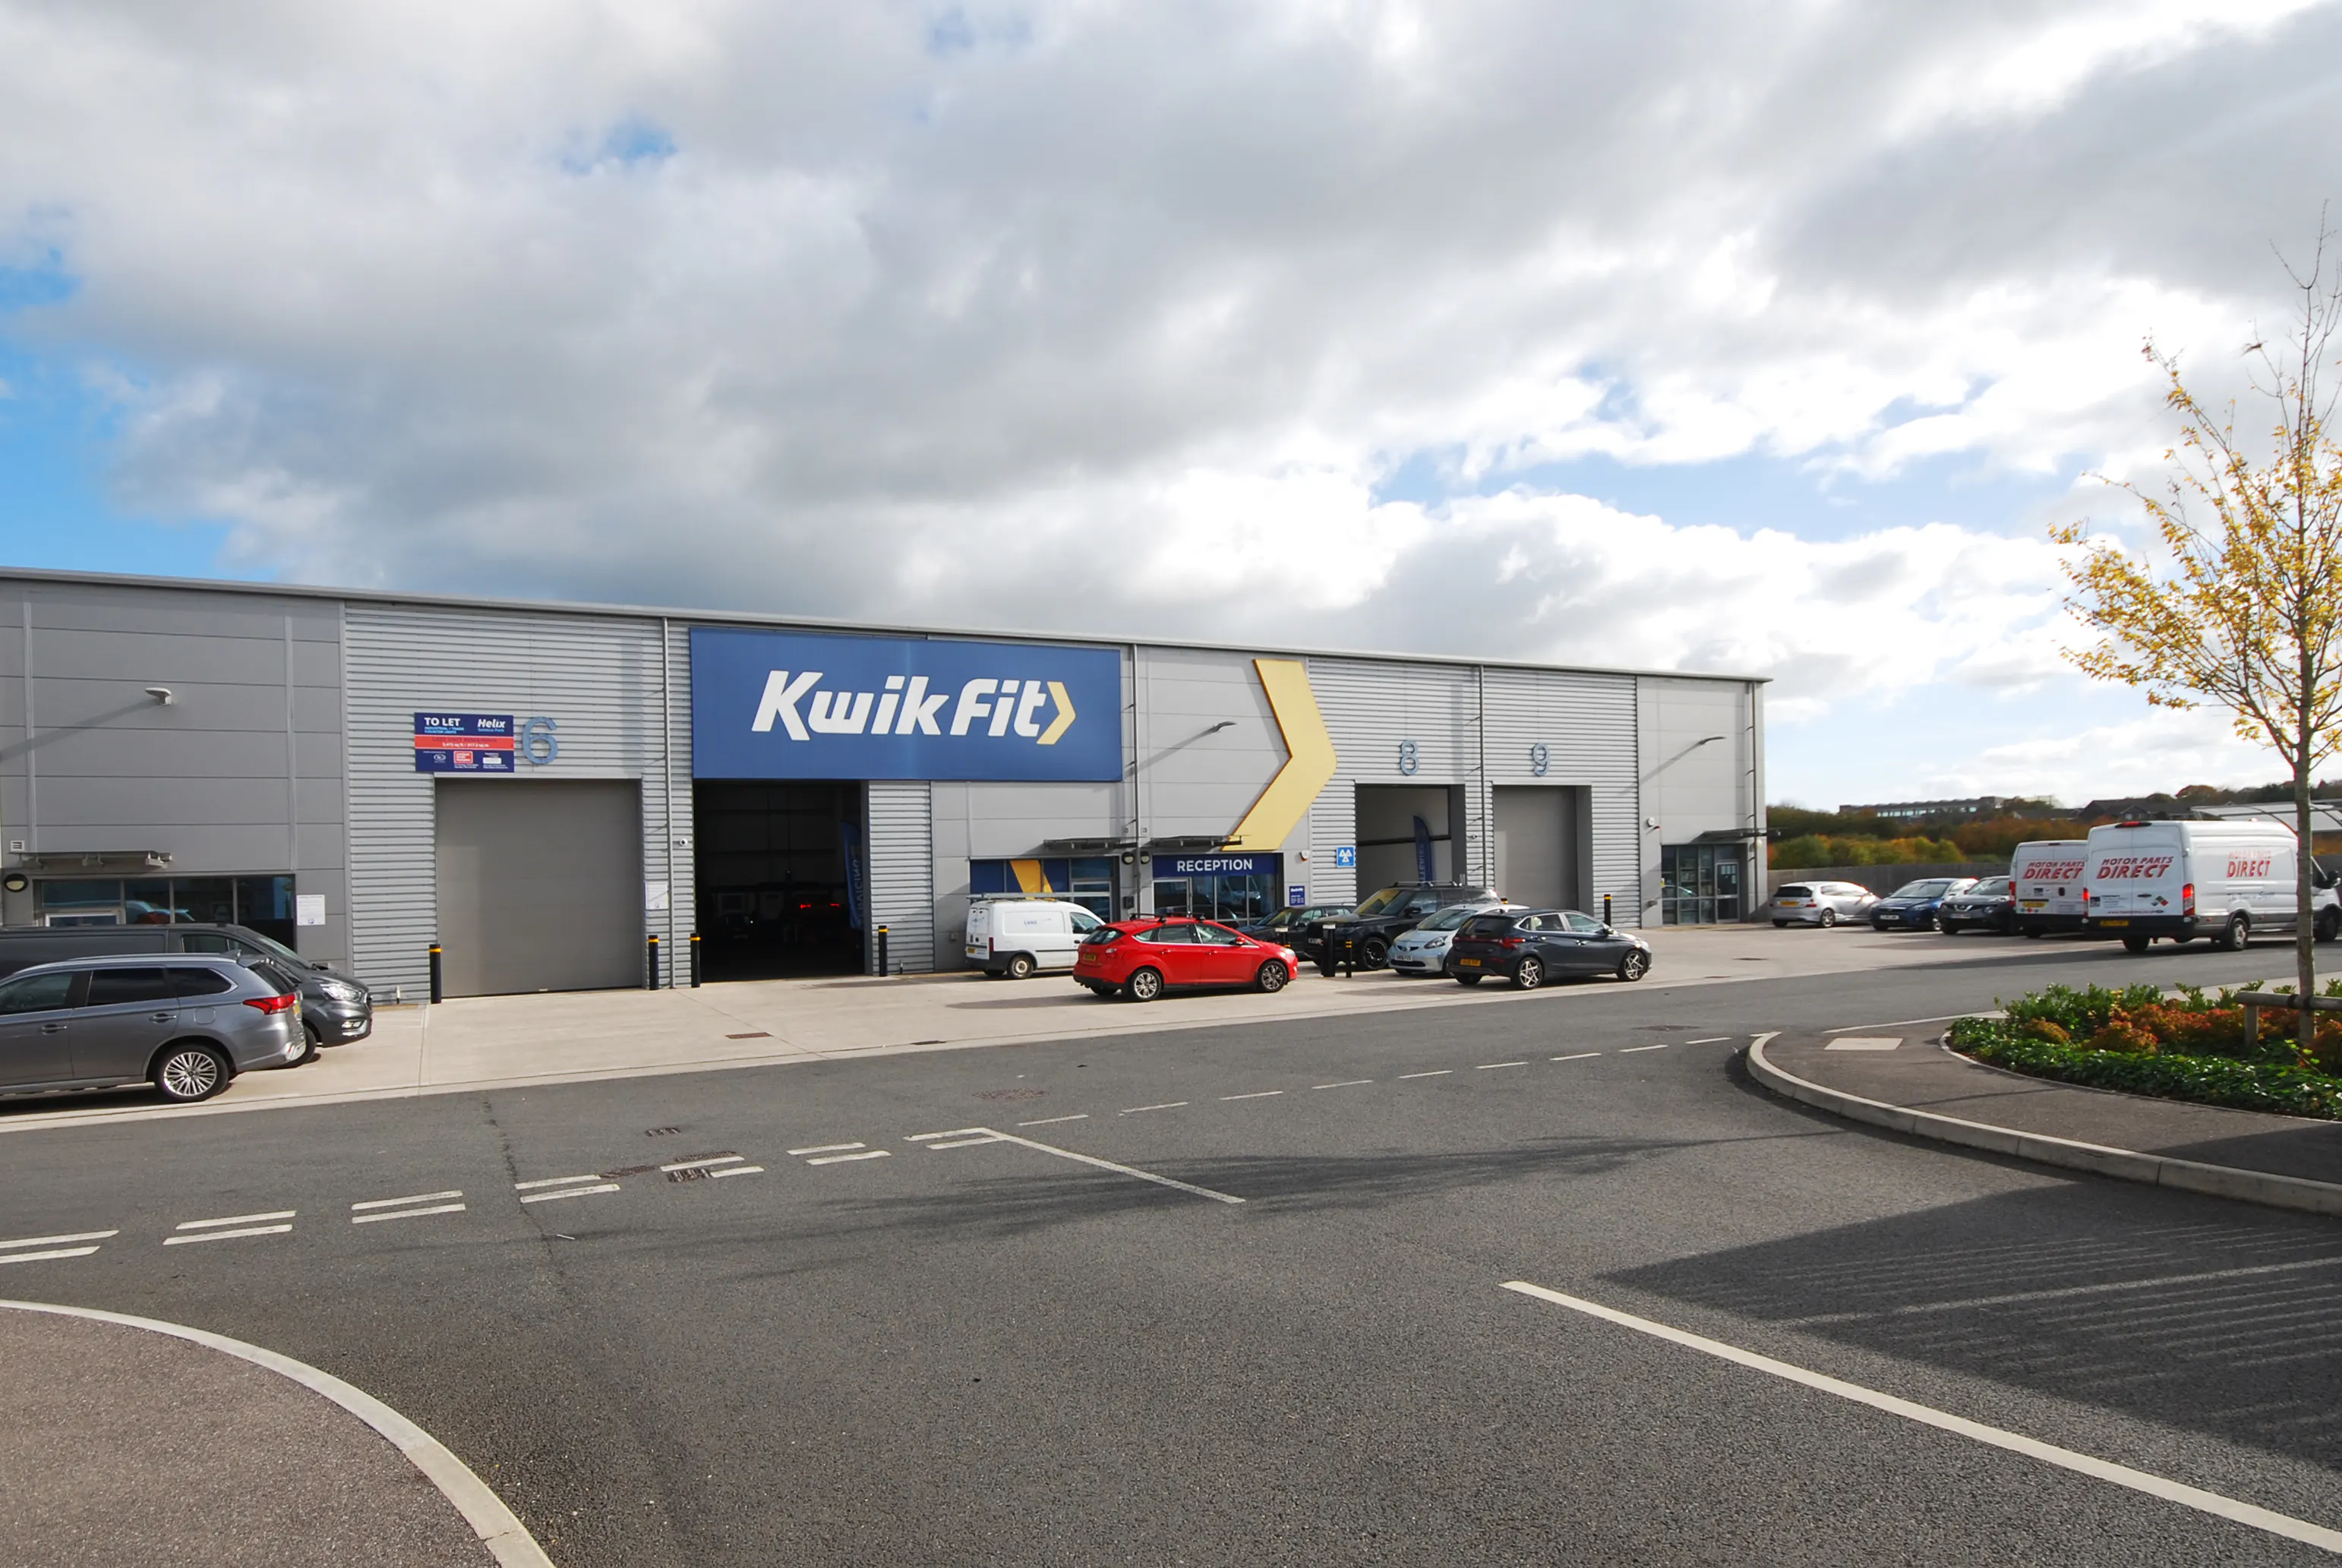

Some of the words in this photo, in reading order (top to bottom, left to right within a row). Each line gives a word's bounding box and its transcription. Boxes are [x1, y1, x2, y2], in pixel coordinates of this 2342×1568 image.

[751, 670, 950, 741] Kwik
[949, 678, 1047, 737] Fit
[424, 717, 440, 726] TO
[442, 718, 461, 727] LET
[477, 718, 506, 728] Helix
[522, 716, 558, 765] 6
[1400, 740, 1419, 776] 8
[1532, 742, 1550, 777] 9
[1176, 859, 1252, 872] RECEPTION
[2101, 857, 2138, 866] MOTOR
[2140, 856, 2174, 864] PARTS
[2022, 868, 2083, 879] DIRECT
[2096, 864, 2170, 879] DIRECT
[2226, 860, 2271, 878] DIRECT
